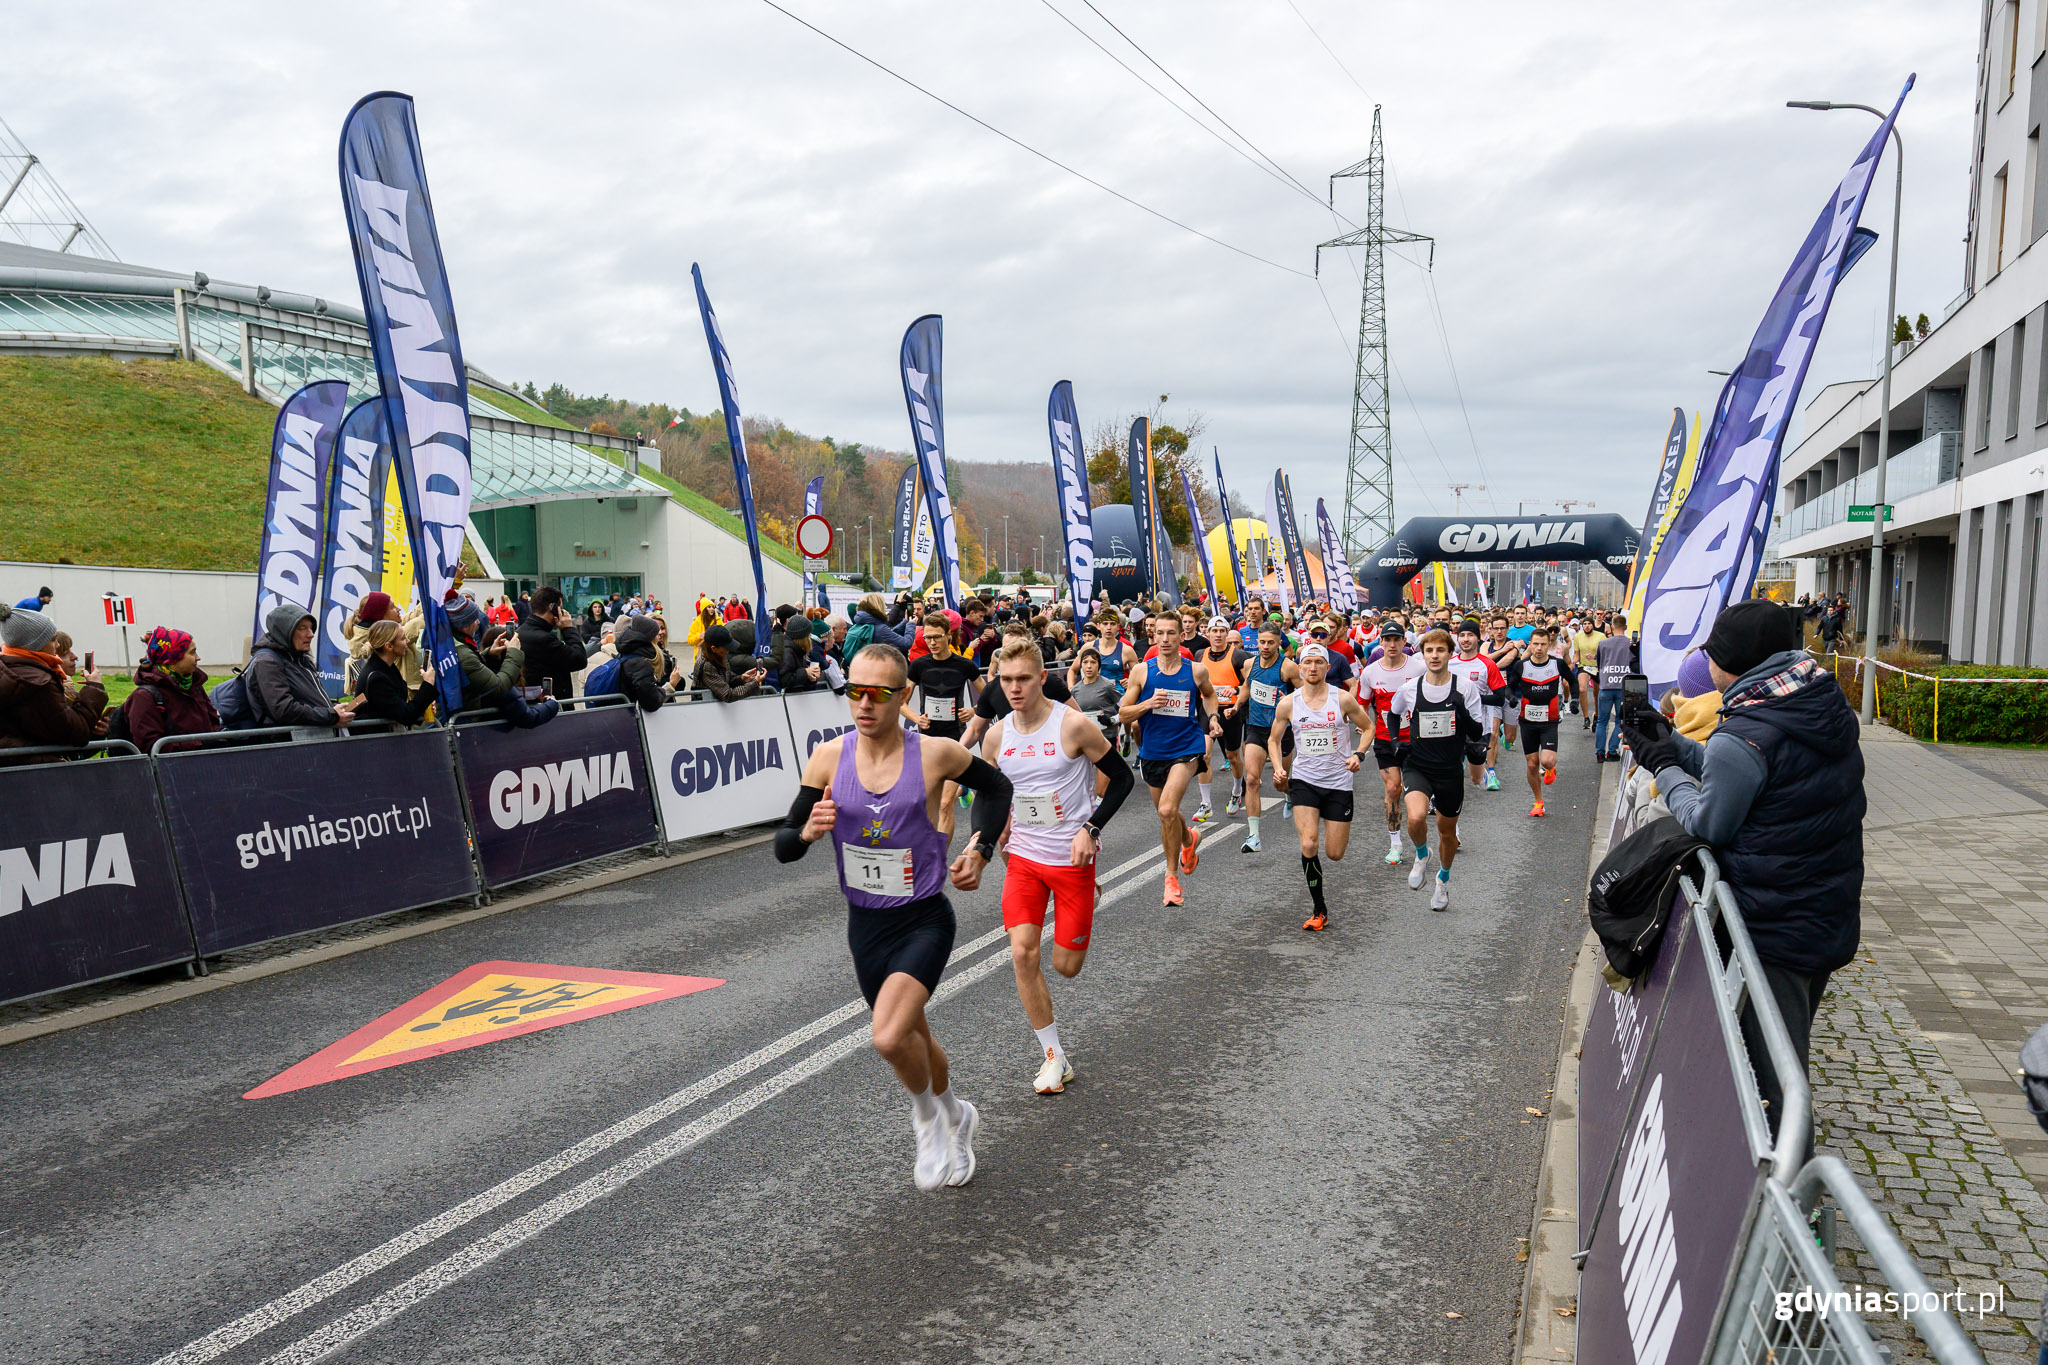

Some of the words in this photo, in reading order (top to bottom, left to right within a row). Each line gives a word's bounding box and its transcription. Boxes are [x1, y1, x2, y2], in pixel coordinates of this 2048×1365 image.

[903, 479, 913, 527] PEKAZET
[920, 514, 928, 525] TO
[1053, 419, 1093, 617] GDYNIA
[916, 530, 926, 553] NICE
[1438, 522, 1586, 553] GDYNIA
[900, 530, 911, 562] Grupa
[922, 536, 931, 554] FIT
[1093, 558, 1137, 568] GDYNIA
[1378, 558, 1418, 567] GDYNIA
[1606, 555, 1634, 565] GDYN
[1111, 566, 1136, 578] sport
[112, 602, 125, 620] H
[1603, 665, 1631, 673] MEDIA
[1608, 676, 1622, 684] 007
[1254, 688, 1267, 698] 390
[1164, 698, 1181, 708] 700
[1432, 721, 1438, 729] 2
[1306, 738, 1329, 747] 3723
[671, 737, 784, 797] GDYNIA
[489, 750, 634, 830] GDYNIA
[1029, 806, 1038, 817] 3
[236, 797, 431, 869] gdyniasport.pl
[0, 832, 136, 917] NIA
[862, 865, 881, 879] 11
